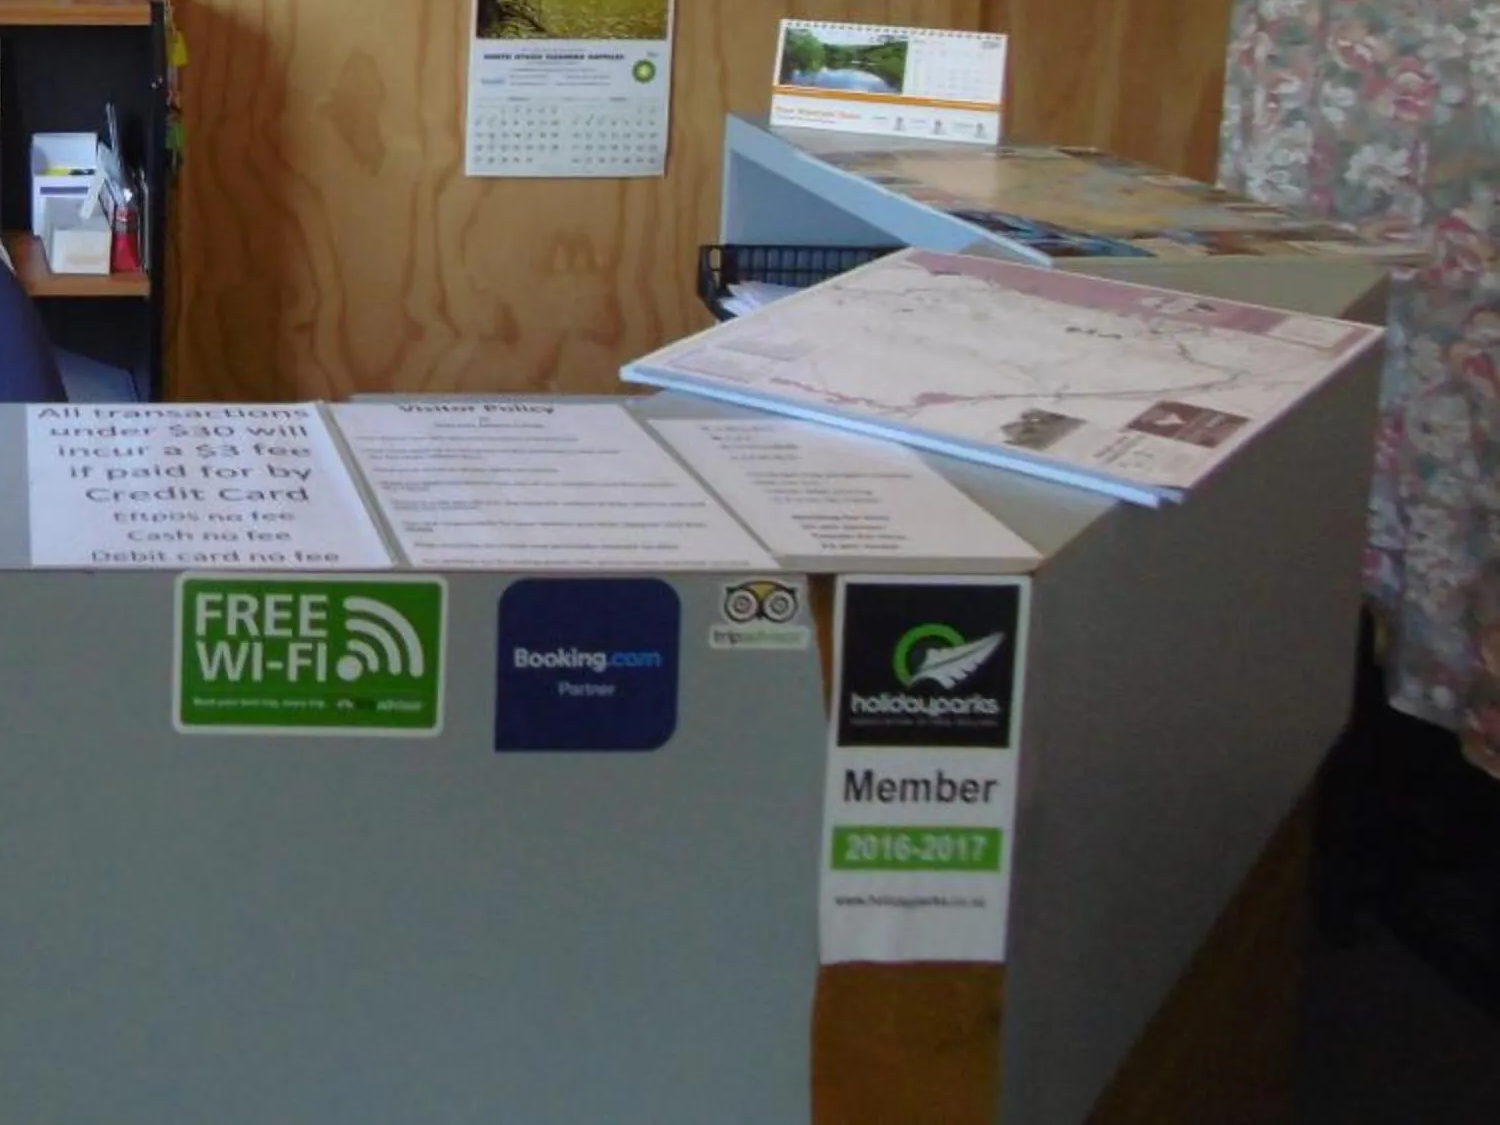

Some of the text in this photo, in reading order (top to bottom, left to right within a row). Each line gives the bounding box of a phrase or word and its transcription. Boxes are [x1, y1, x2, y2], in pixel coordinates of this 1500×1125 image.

[37, 407, 311, 419] All transactions
[49, 424, 308, 439] under $30 will
[58, 443, 312, 458] incur a $3 fee
[69, 464, 312, 482] if paid for by
[85, 486, 310, 502] Credit Card
[208, 513, 244, 523] no
[252, 511, 296, 523] fee
[127, 530, 292, 542] Cash no fee
[90, 551, 340, 563] Debit card no fee
[195, 593, 328, 638] FREE
[195, 641, 328, 683] WI-FI
[514, 647, 662, 673] Booking.com
[557, 681, 617, 696] Partner
[843, 769, 999, 805] Member
[844, 832, 988, 862] 2016-2017
